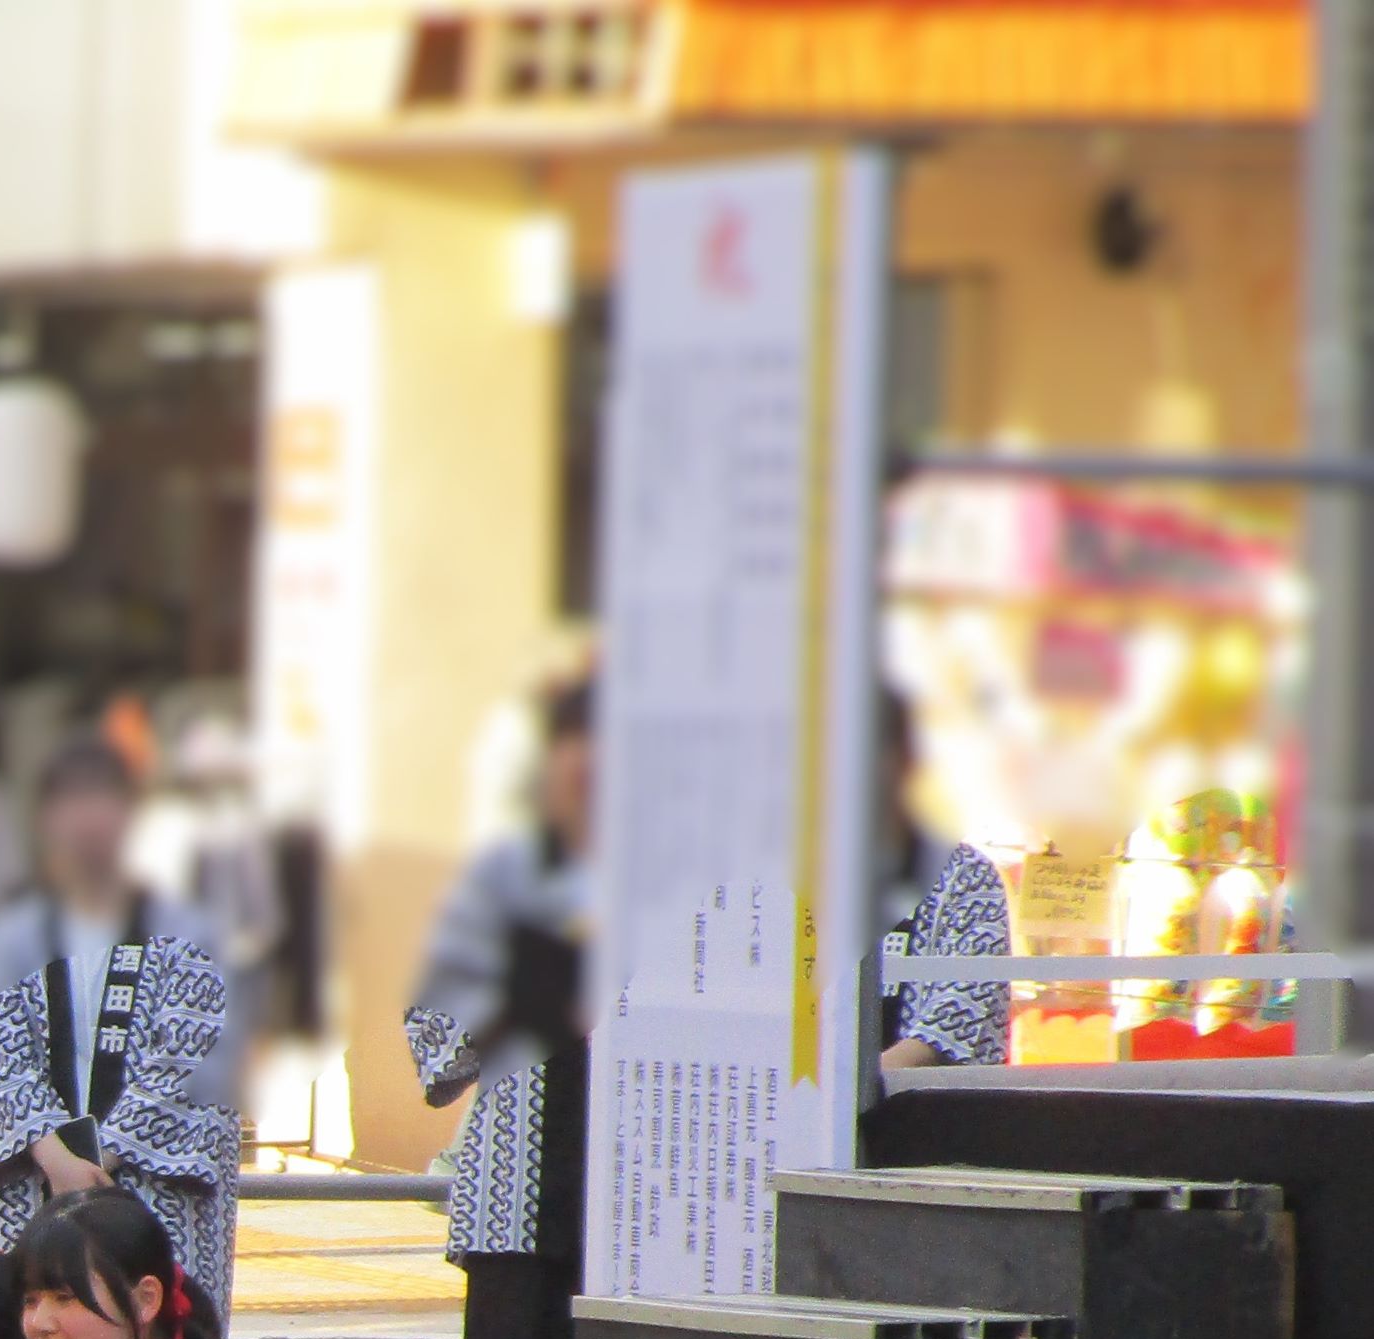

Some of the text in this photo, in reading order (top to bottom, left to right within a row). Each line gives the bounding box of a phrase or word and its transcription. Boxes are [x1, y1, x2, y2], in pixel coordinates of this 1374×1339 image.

[97, 944, 144, 1054] 酒田市
[704, 1064, 720, 1293] ㈱荘内日報社酒田
